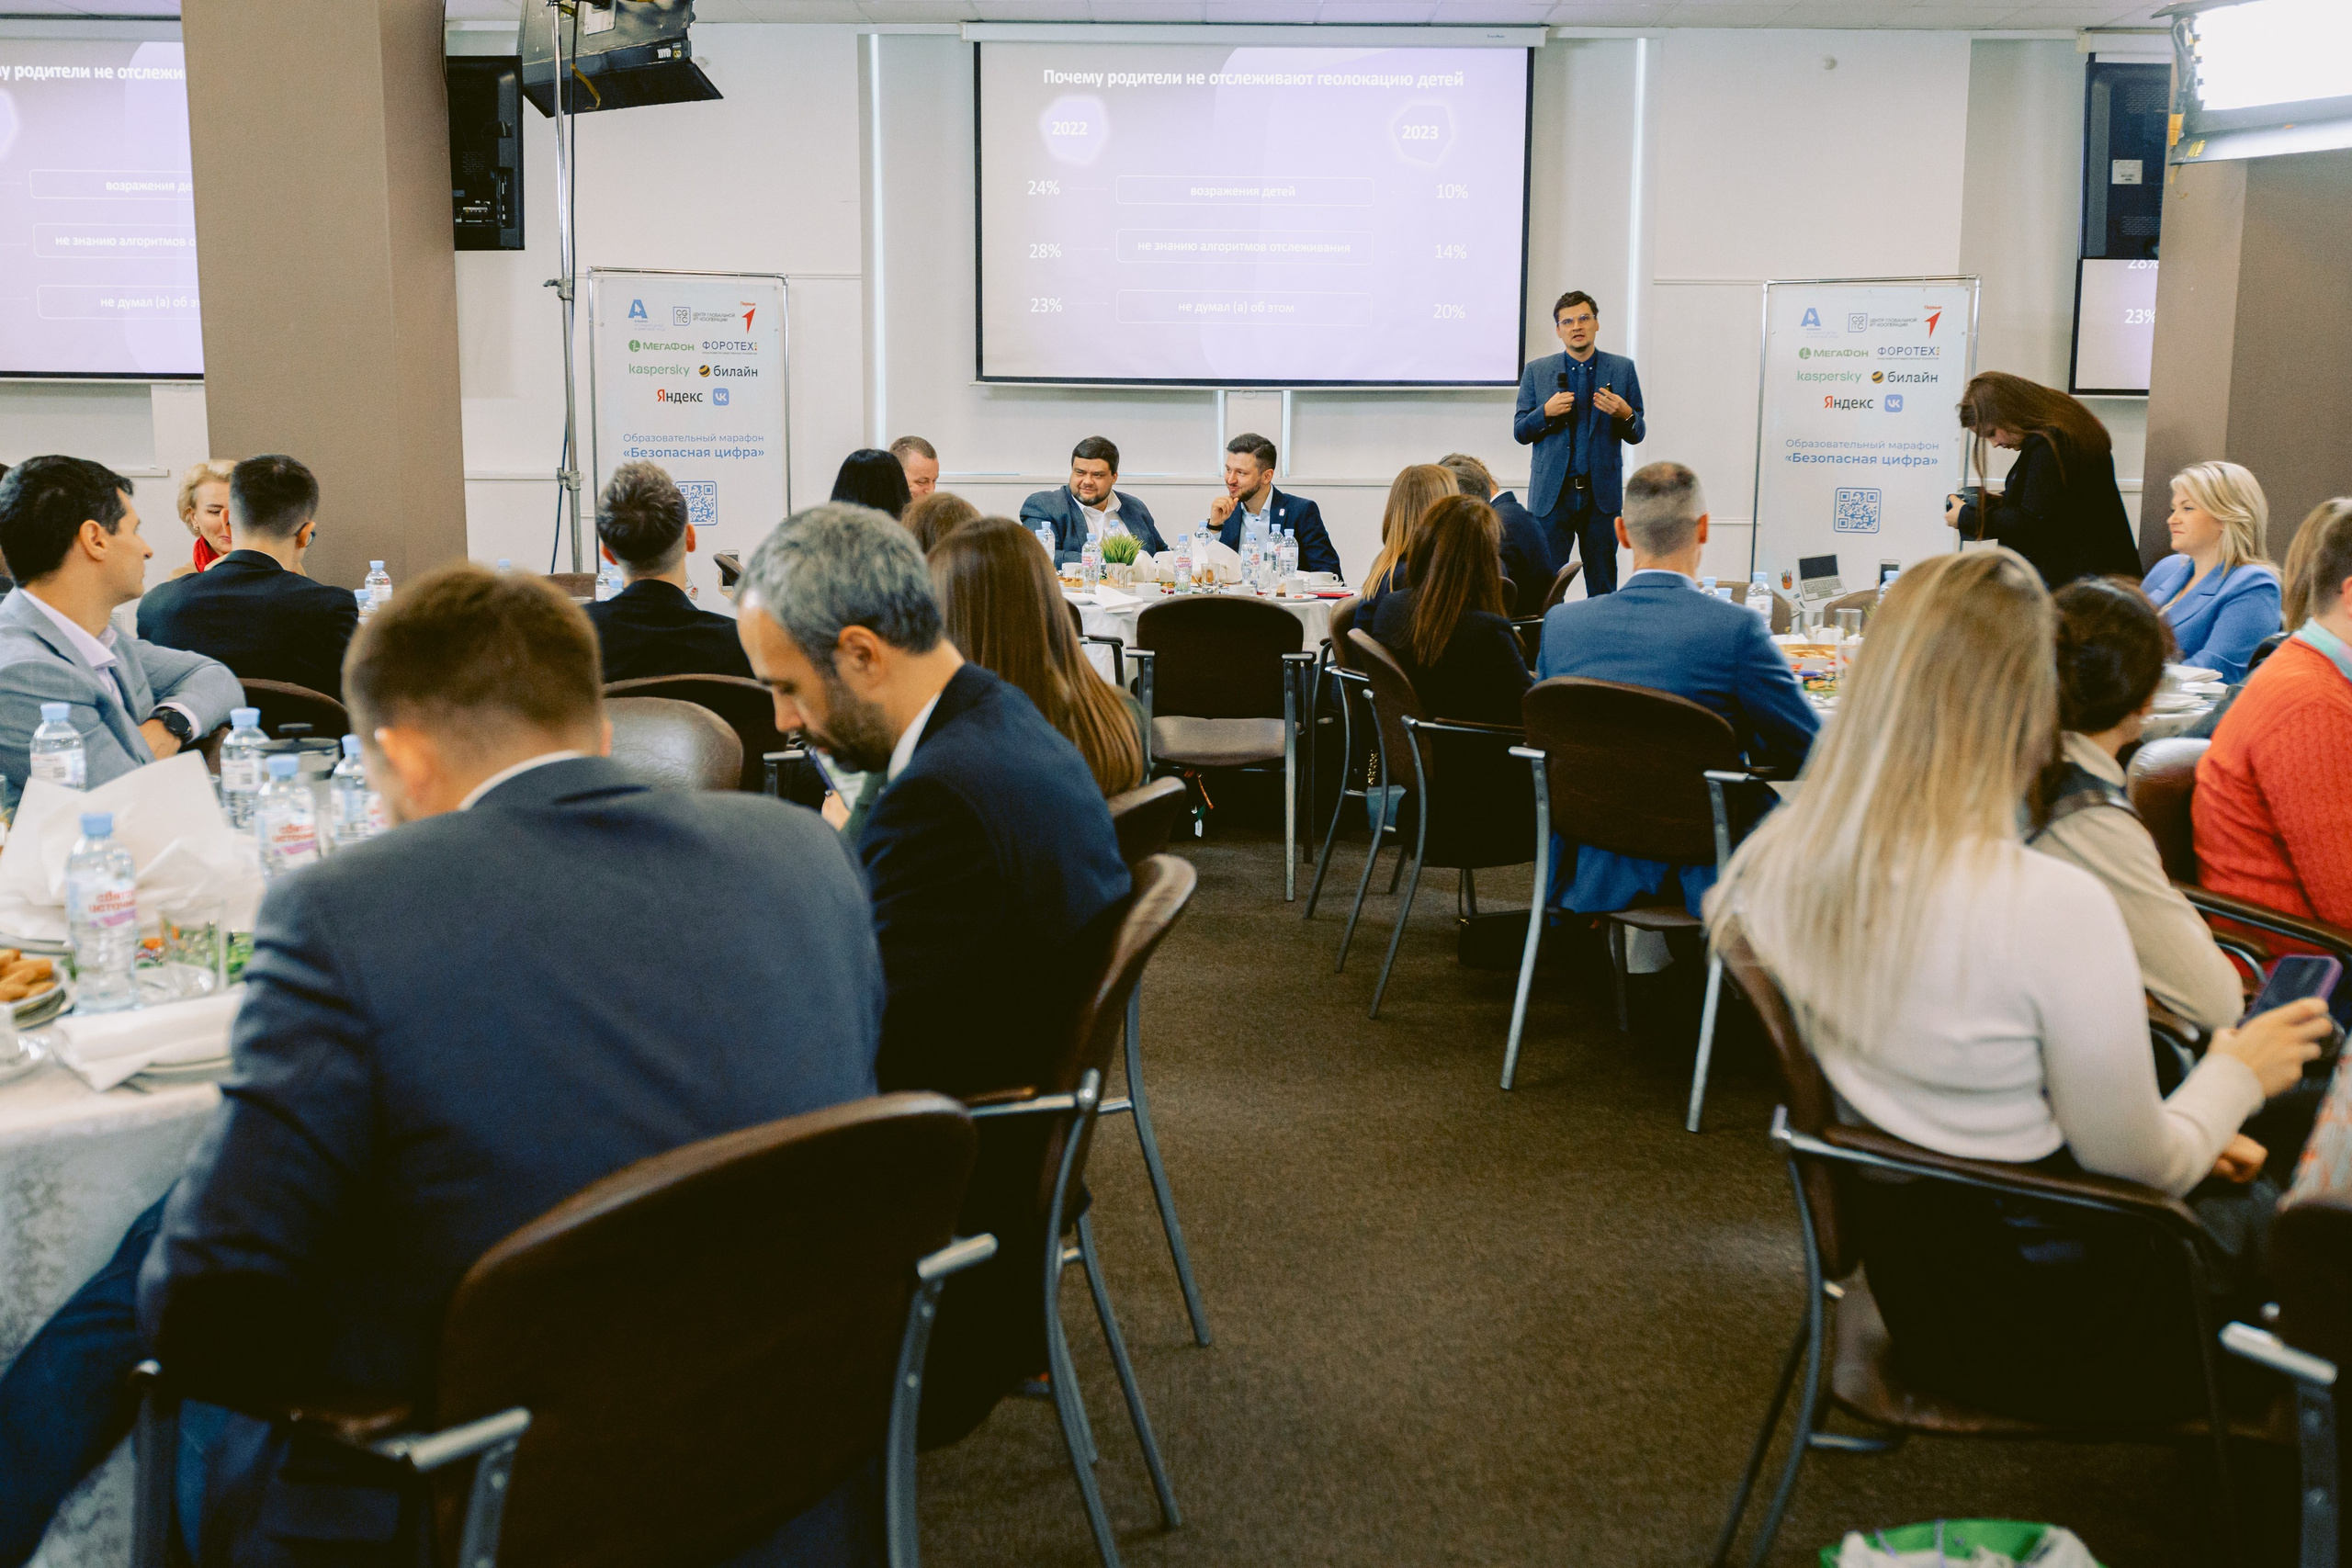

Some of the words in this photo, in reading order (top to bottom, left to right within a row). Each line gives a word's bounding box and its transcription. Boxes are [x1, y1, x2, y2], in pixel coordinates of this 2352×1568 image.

[14, 65, 91, 81] родители
[95, 67, 113, 79] не
[1044, 70, 1103, 87] Почему
[1108, 72, 1182, 87] родители
[1186, 73, 1205, 85] не
[1208, 73, 1314, 85] отслеживают
[1317, 73, 1414, 88] геолокацию
[1417, 71, 1464, 88] детей
[1051, 120, 1089, 136] 2022
[1402, 125, 1440, 140] 2023
[106, 181, 175, 192] возражения
[1027, 180, 1060, 196] 24%
[1190, 186, 1259, 197] возражения
[1261, 186, 1296, 198] детей
[1436, 183, 1469, 199] 10%
[55, 236, 69, 246] не
[73, 236, 116, 246] знанию
[119, 237, 186, 248] алгоритмов
[1137, 242, 1151, 251] не
[1154, 242, 1198, 252] знанию
[1200, 242, 1267, 253] алгоритмов
[1270, 243, 1351, 254] отслеживания
[1029, 243, 1062, 258] 28%
[1434, 243, 1467, 259] 14%
[100, 299, 115, 308] не
[118, 299, 152, 310] думал
[155, 296, 170, 310] (а)
[173, 296, 187, 308] об
[1030, 297, 1063, 312] 23%
[1178, 302, 1192, 312] не
[1194, 302, 1229, 314] думал
[1233, 300, 1248, 315] (а)
[1250, 300, 1264, 312] об
[1267, 303, 1295, 313] этом
[1433, 303, 1465, 319] 20%
[628, 364, 690, 378] kaspersky
[713, 365, 758, 377] билайн
[1797, 370, 1862, 384] kaspersky
[1887, 371, 1938, 383] билайн
[657, 389, 703, 403] Яндекс
[1824, 396, 1873, 410] Яндекс
[623, 433, 717, 444] Образовательный
[719, 434, 764, 444] марафон
[1785, 438, 1884, 449] Образовательный
[1888, 441, 1939, 451] марафон
[623, 447, 710, 457] «Безопасная
[715, 446, 764, 459] цифра»
[1785, 453, 1877, 464] «Безопасная
[1883, 455, 1938, 467] цифра»
